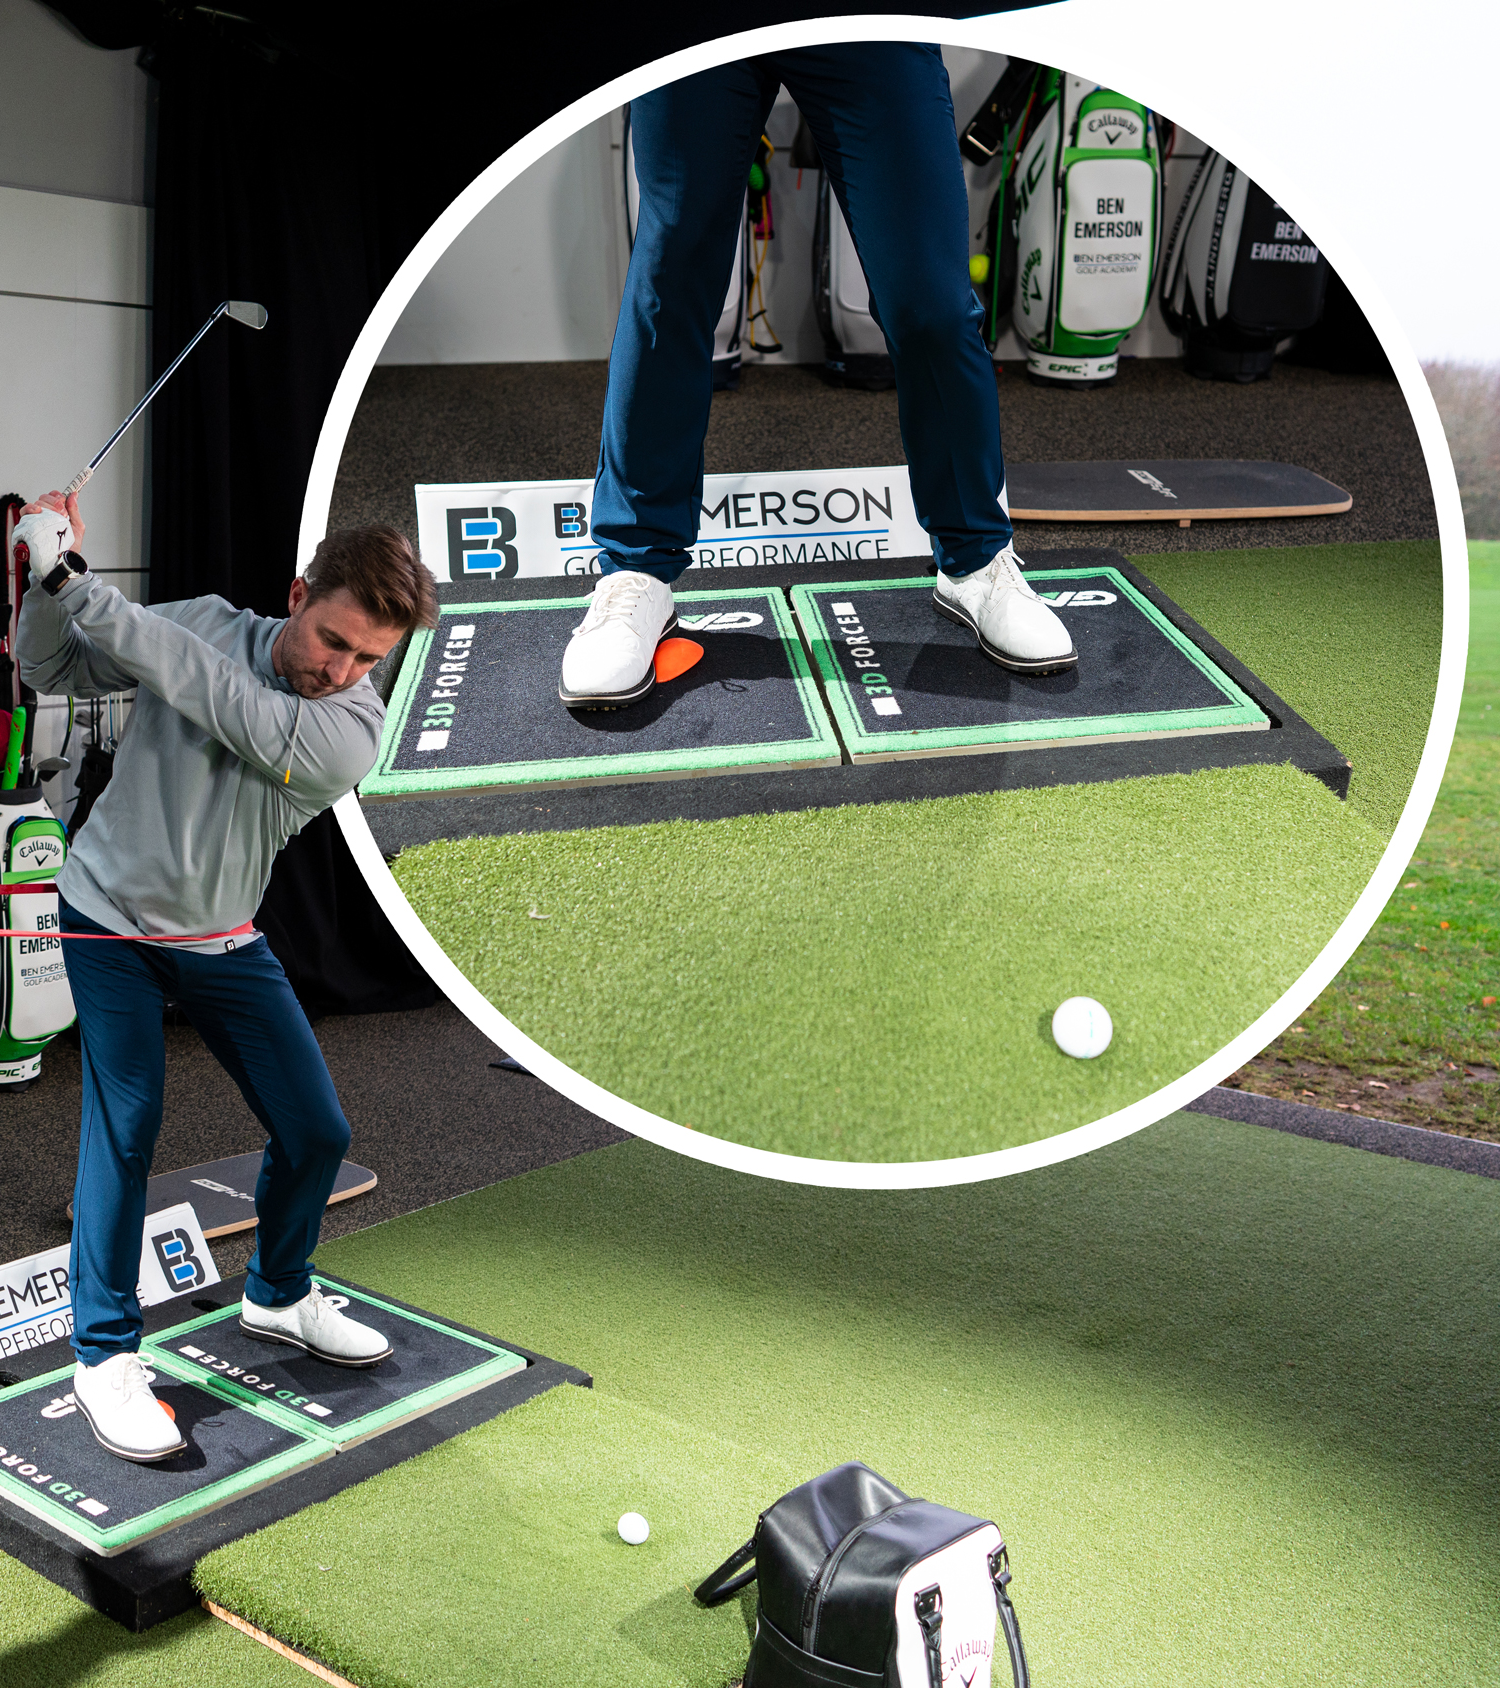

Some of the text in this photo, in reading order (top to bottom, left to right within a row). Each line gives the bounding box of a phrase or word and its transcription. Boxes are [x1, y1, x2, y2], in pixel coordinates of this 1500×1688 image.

[1088, 113, 1139, 136] Callaway
[1097, 198, 1124, 215] BEN
[1074, 221, 1142, 238] EMERSON
[1274, 221, 1303, 240] BEN
[1096, 253, 1142, 263] EMERSON
[1250, 242, 1319, 264] EMERSON
[1048, 362, 1083, 373] EPIC
[699, 486, 893, 531] MERSON
[836, 616, 893, 695] 3D FORCE
[422, 640, 473, 728] 3D FORCE
[19, 839, 61, 859] Callaway
[36, 912, 59, 931] BEN
[19, 936, 61, 955] EMERS
[21, 961, 65, 977] BEN EMERS
[23, 979, 43, 988] GOLF
[199, 1355, 309, 1406] 3D FORCE
[49, 1482, 86, 1502] 3D
